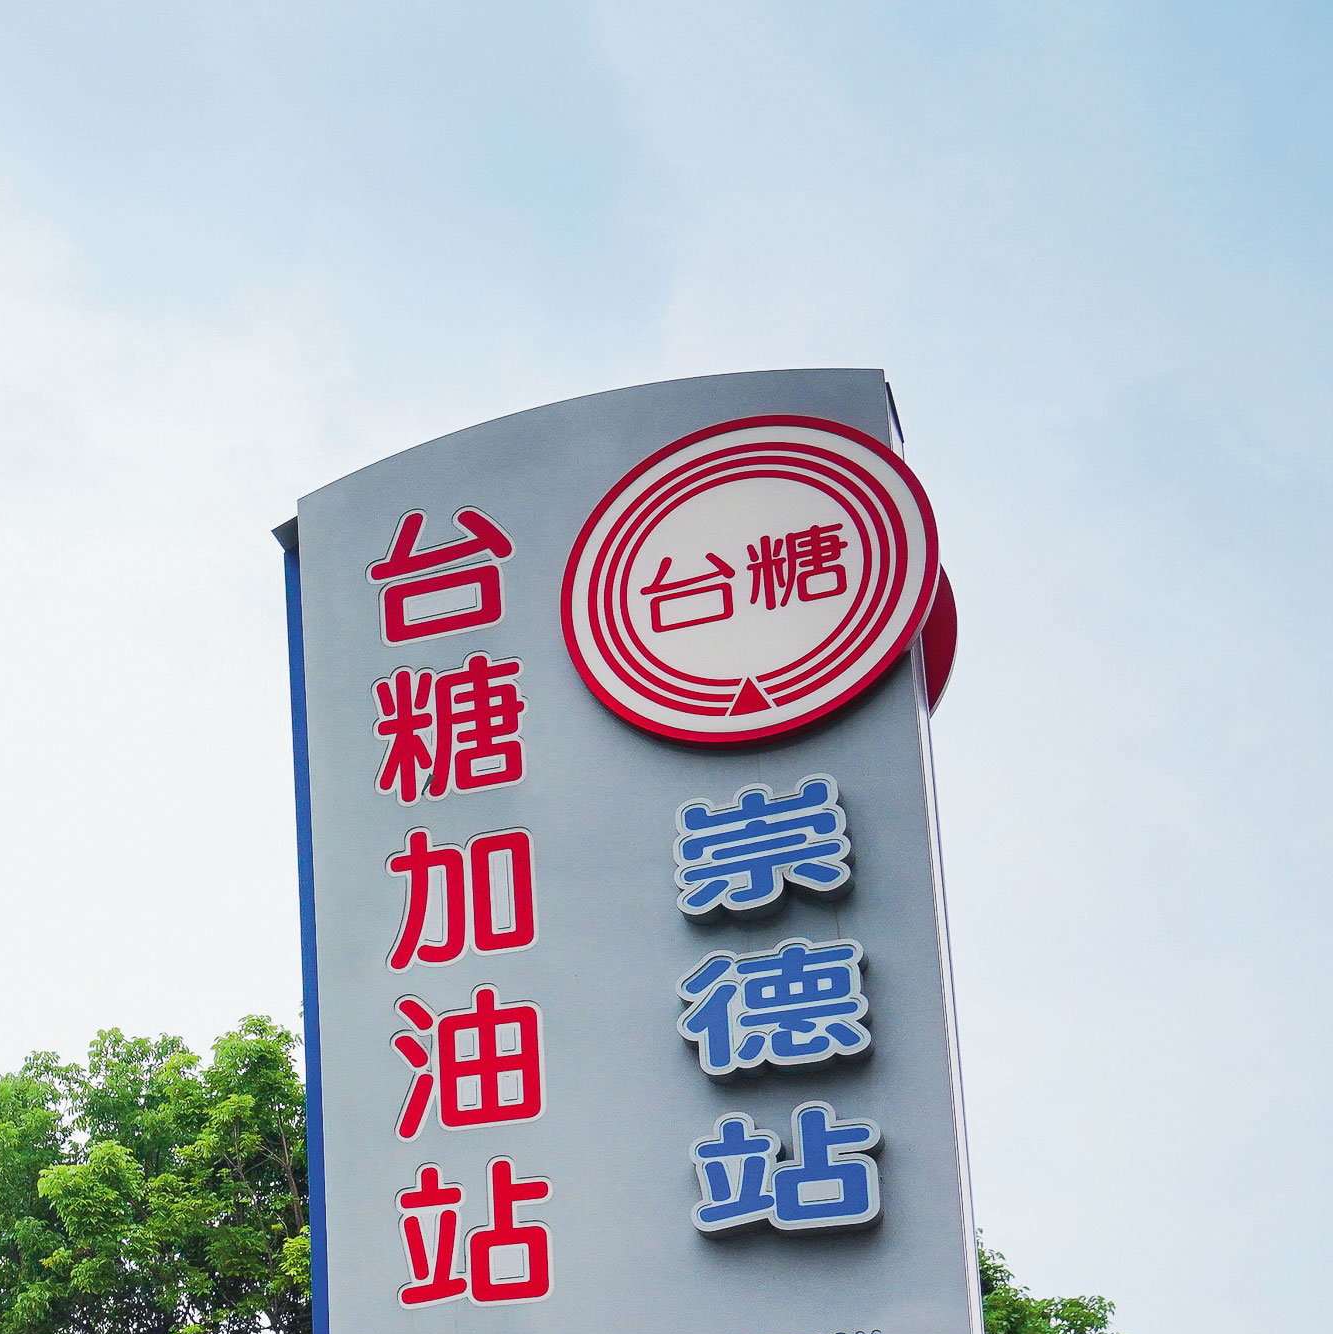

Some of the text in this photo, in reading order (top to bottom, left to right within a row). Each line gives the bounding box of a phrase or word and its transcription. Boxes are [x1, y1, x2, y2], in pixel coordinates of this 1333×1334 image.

[639, 523, 850, 634] 台糖
[368, 507, 552, 1306] 台糖加油站
[678, 776, 876, 1228] 崇德站
